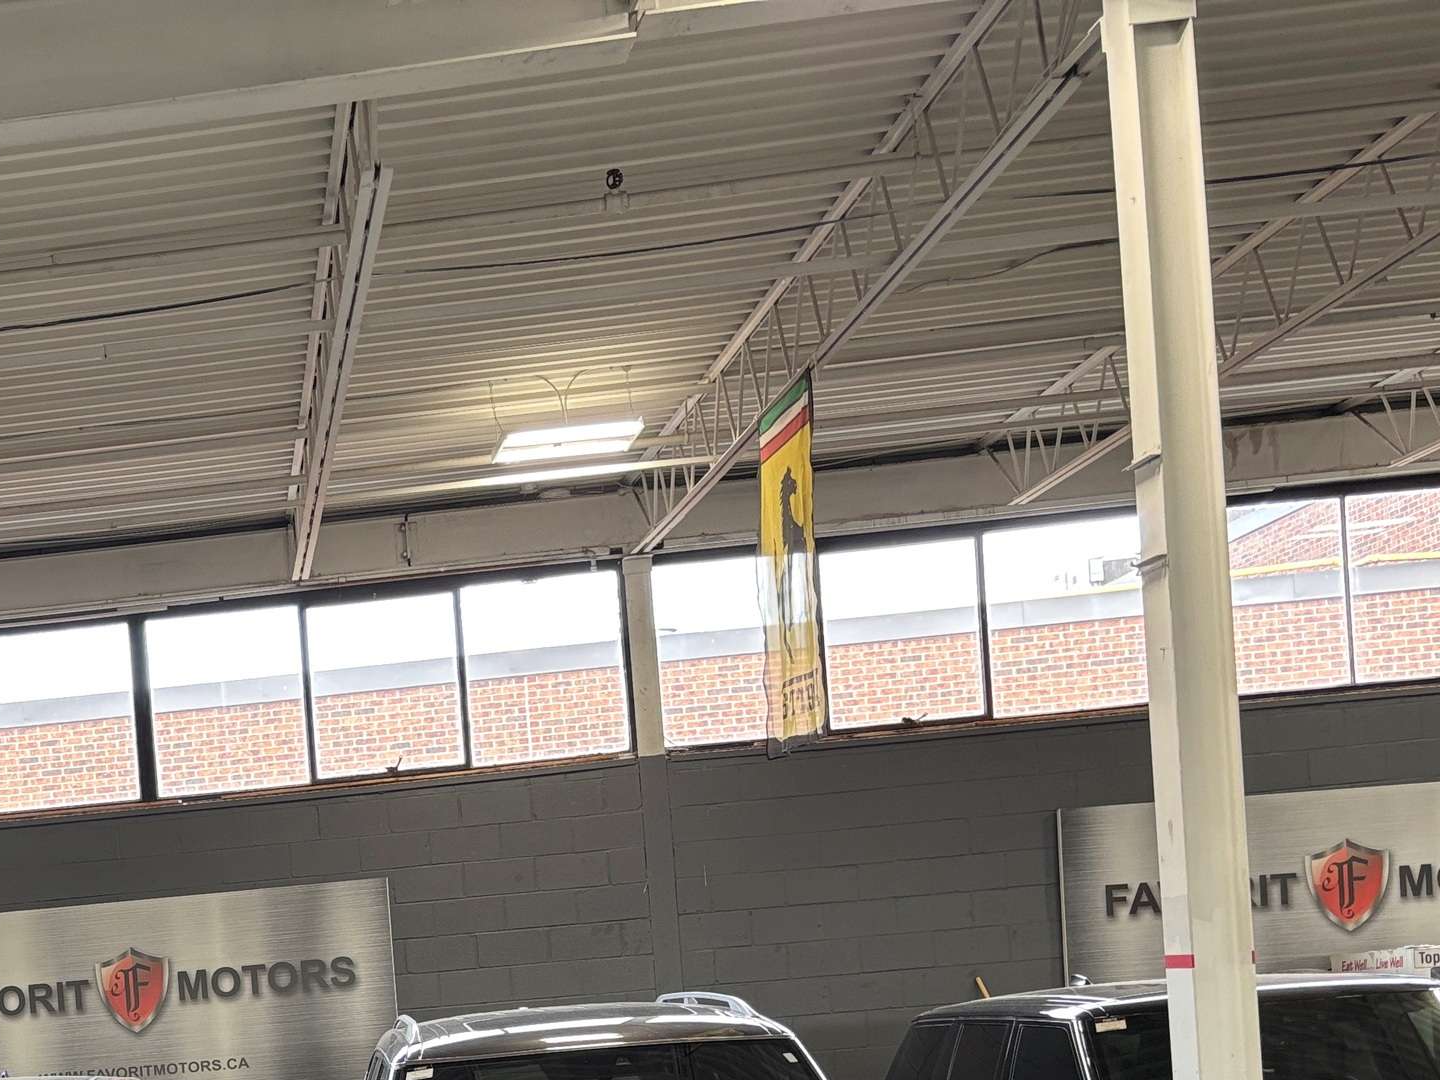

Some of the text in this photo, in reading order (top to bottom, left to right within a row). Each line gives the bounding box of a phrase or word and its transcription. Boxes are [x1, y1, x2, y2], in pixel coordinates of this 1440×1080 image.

[1105, 872, 1297, 917] FAIT
[177, 956, 357, 1001] MOTORS
[1390, 955, 1404, 969] Well
